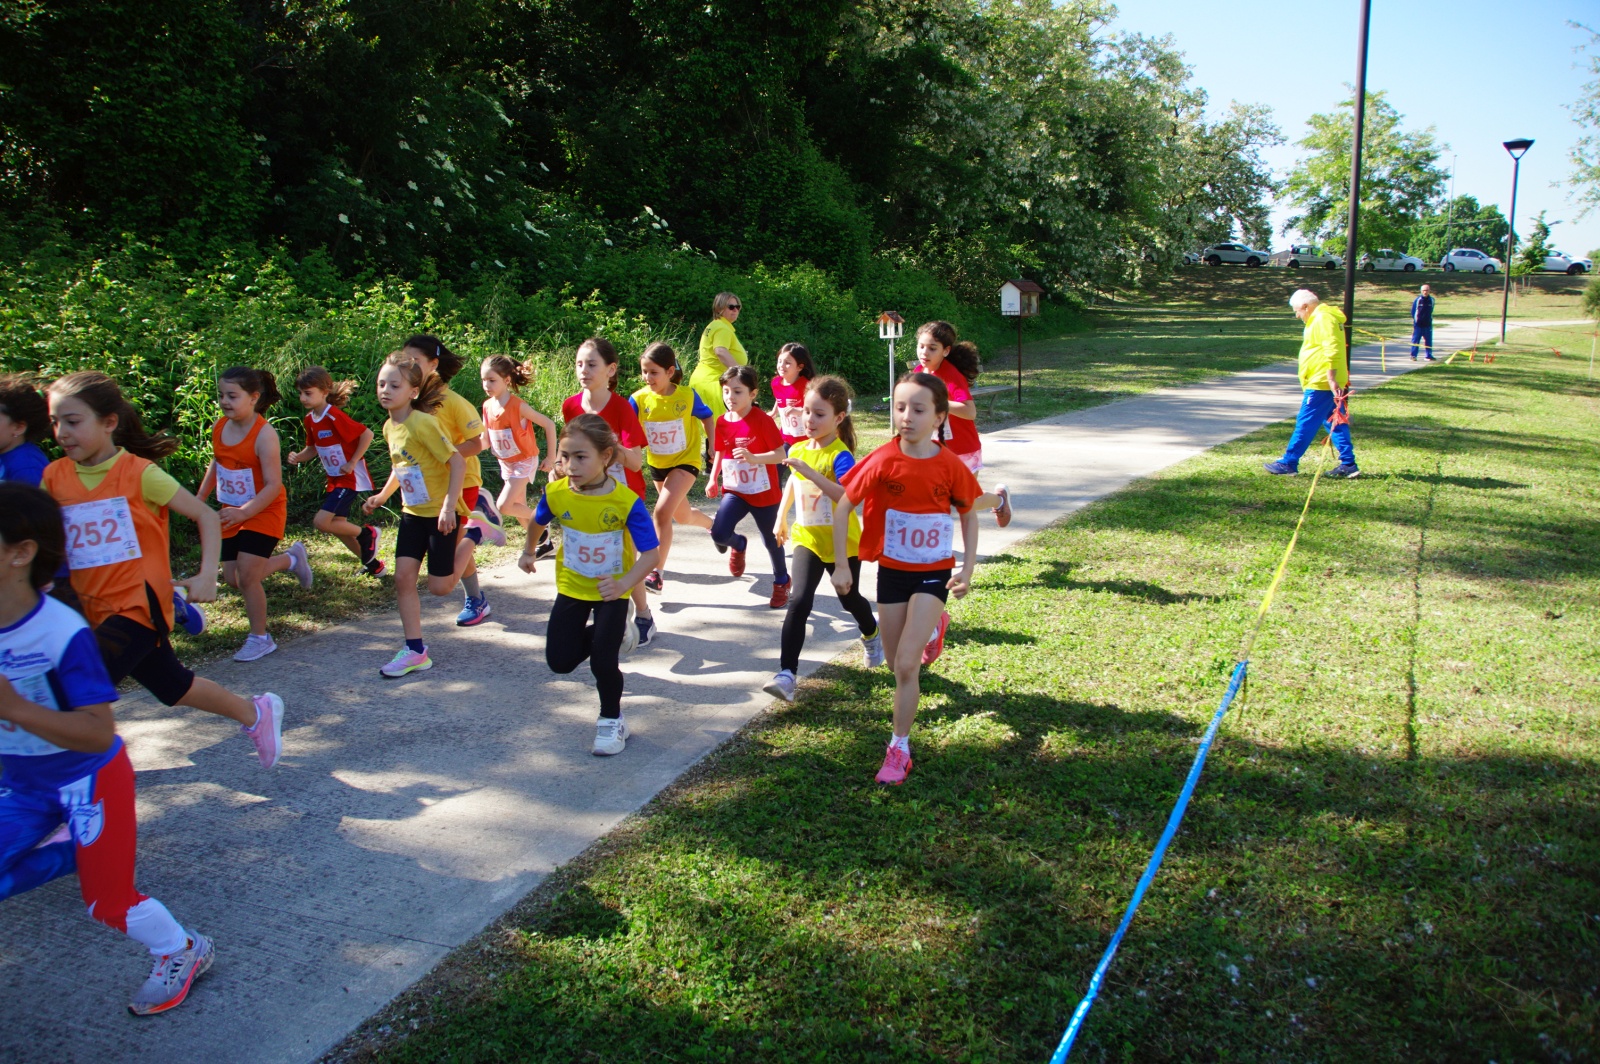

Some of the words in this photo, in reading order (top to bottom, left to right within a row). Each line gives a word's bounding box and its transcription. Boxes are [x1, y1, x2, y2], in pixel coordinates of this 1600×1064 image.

[651, 430, 677, 445] 257
[731, 467, 758, 484] 107
[220, 477, 247, 495] 253
[68, 518, 122, 549] 252
[897, 527, 940, 548] 108
[578, 545, 606, 563] 55
